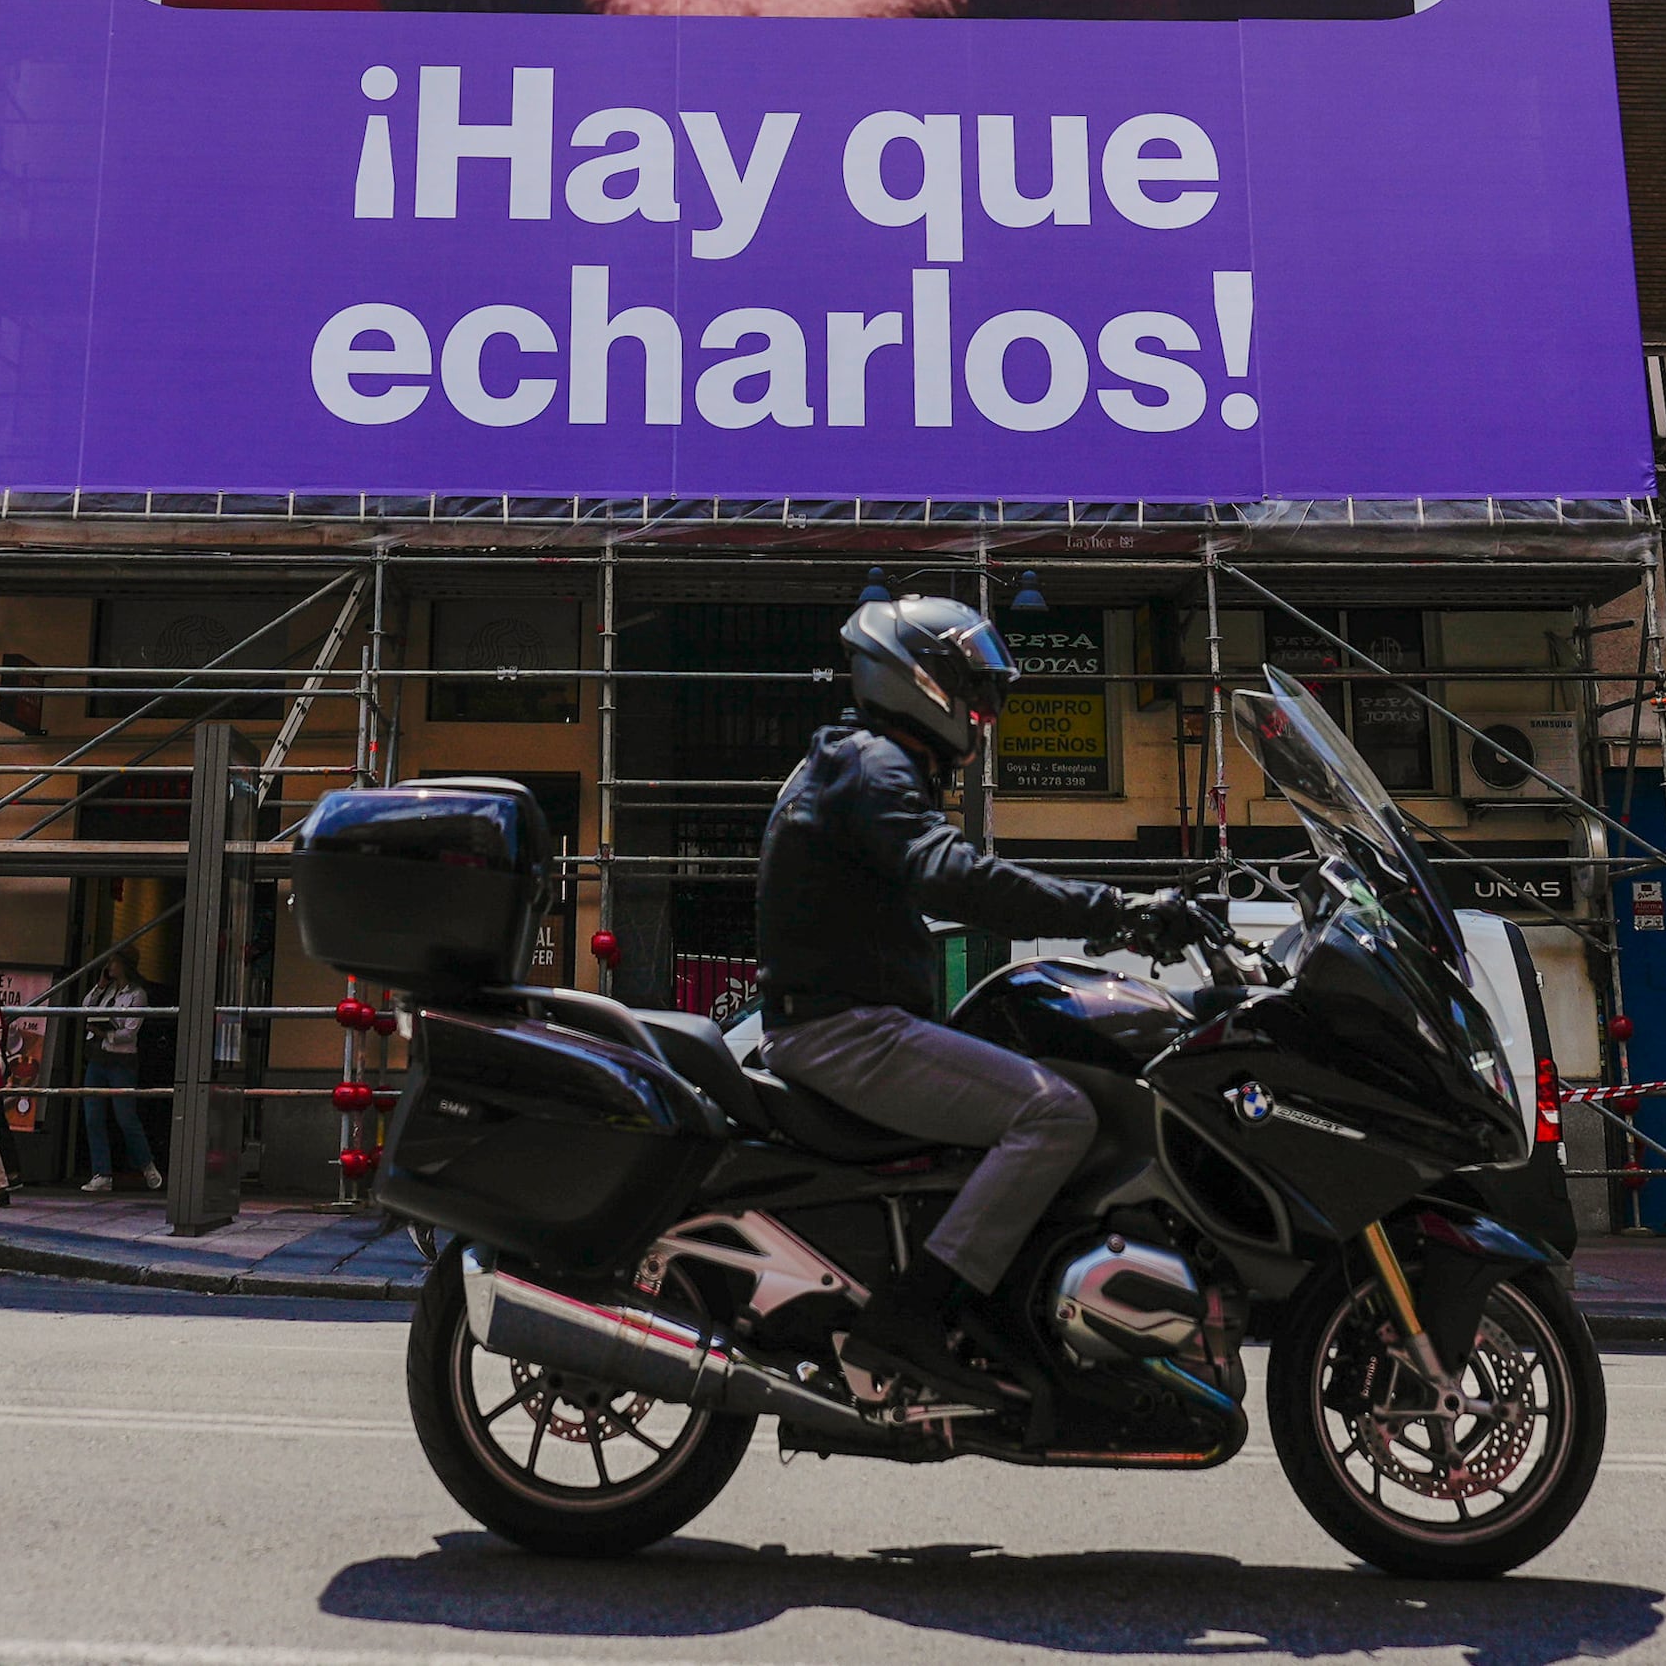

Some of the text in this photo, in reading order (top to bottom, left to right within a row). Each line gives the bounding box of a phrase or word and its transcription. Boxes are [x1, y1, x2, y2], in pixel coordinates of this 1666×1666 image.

[353, 65, 1220, 262] ¡Hay que
[309, 263, 1260, 432] echarlos!
[1004, 633, 1098, 650] PEPA
[1014, 656, 1099, 674] JOYAS
[1007, 700, 1092, 715] COMPRO
[1029, 717, 1071, 732] ORO
[1530, 720, 1573, 729] SAMSUNG
[1003, 734, 1097, 752] EMPEÑOS
[1006, 763, 1028, 774] Goya
[1052, 763, 1097, 774] Entreplanta
[1017, 776, 1086, 786] 911 278 398
[1474, 877, 1562, 899] UÑAS
